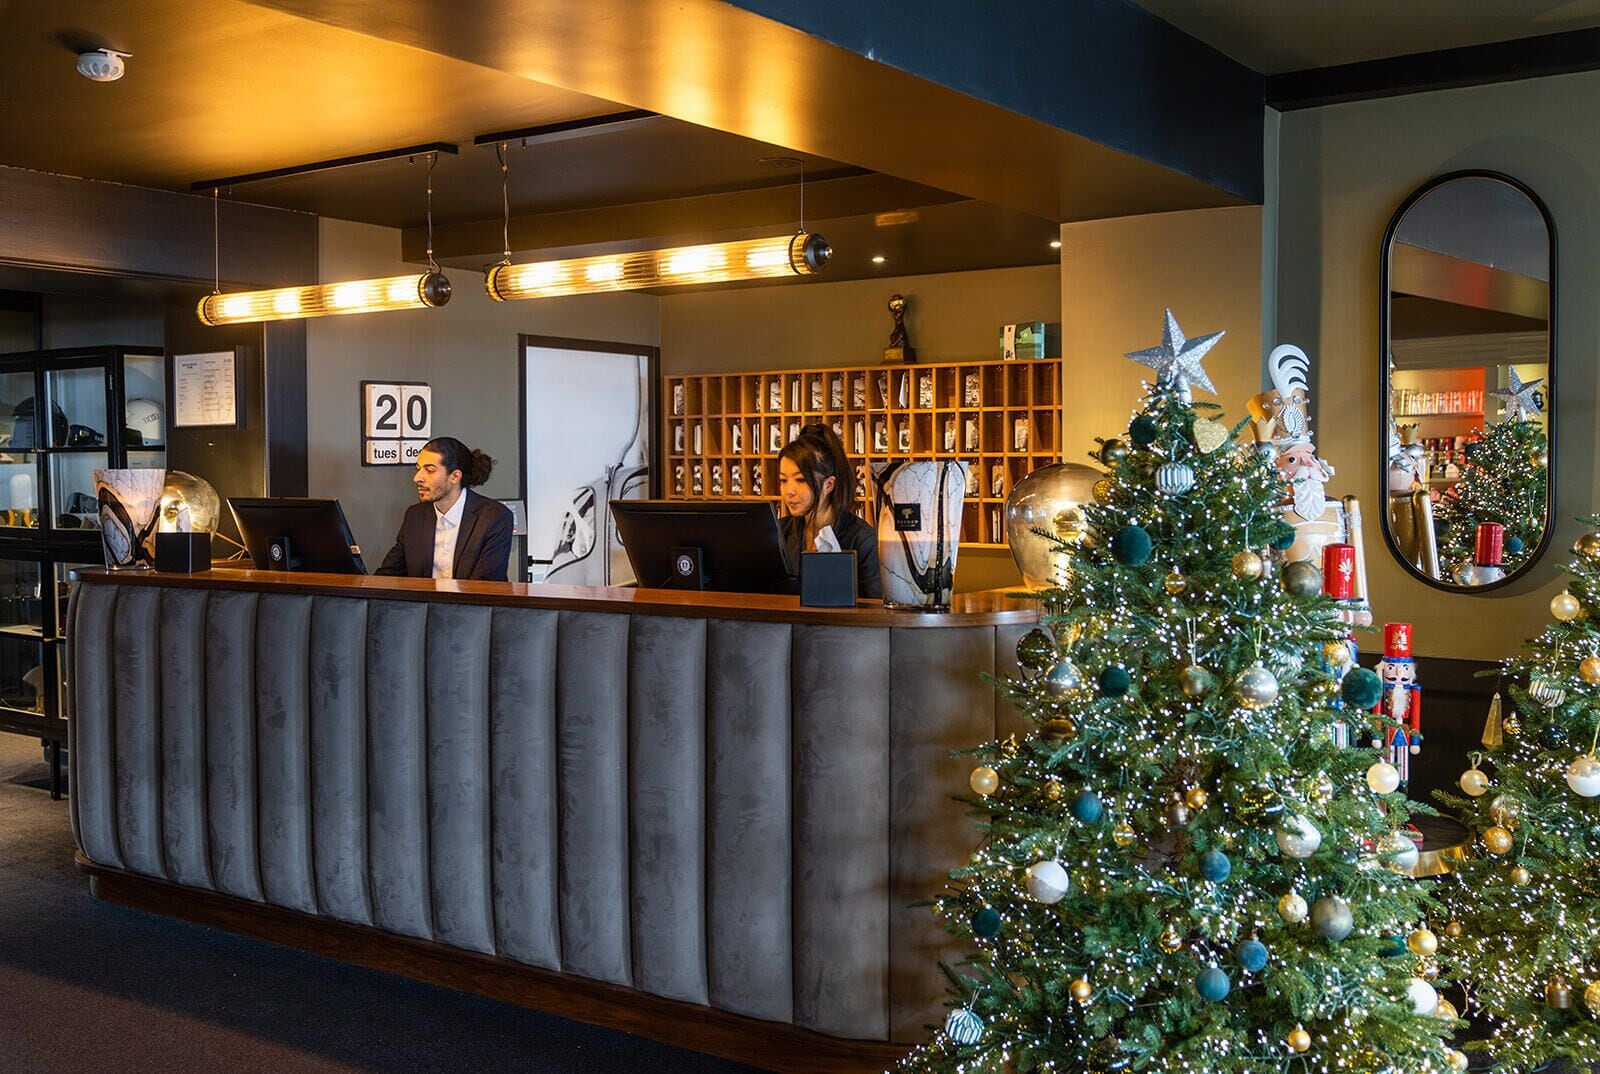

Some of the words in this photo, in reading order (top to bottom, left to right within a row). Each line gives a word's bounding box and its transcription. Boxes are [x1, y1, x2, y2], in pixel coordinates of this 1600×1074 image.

[376, 394, 427, 431] 20
[374, 448, 397, 459] tues
[406, 446, 421, 457] de
